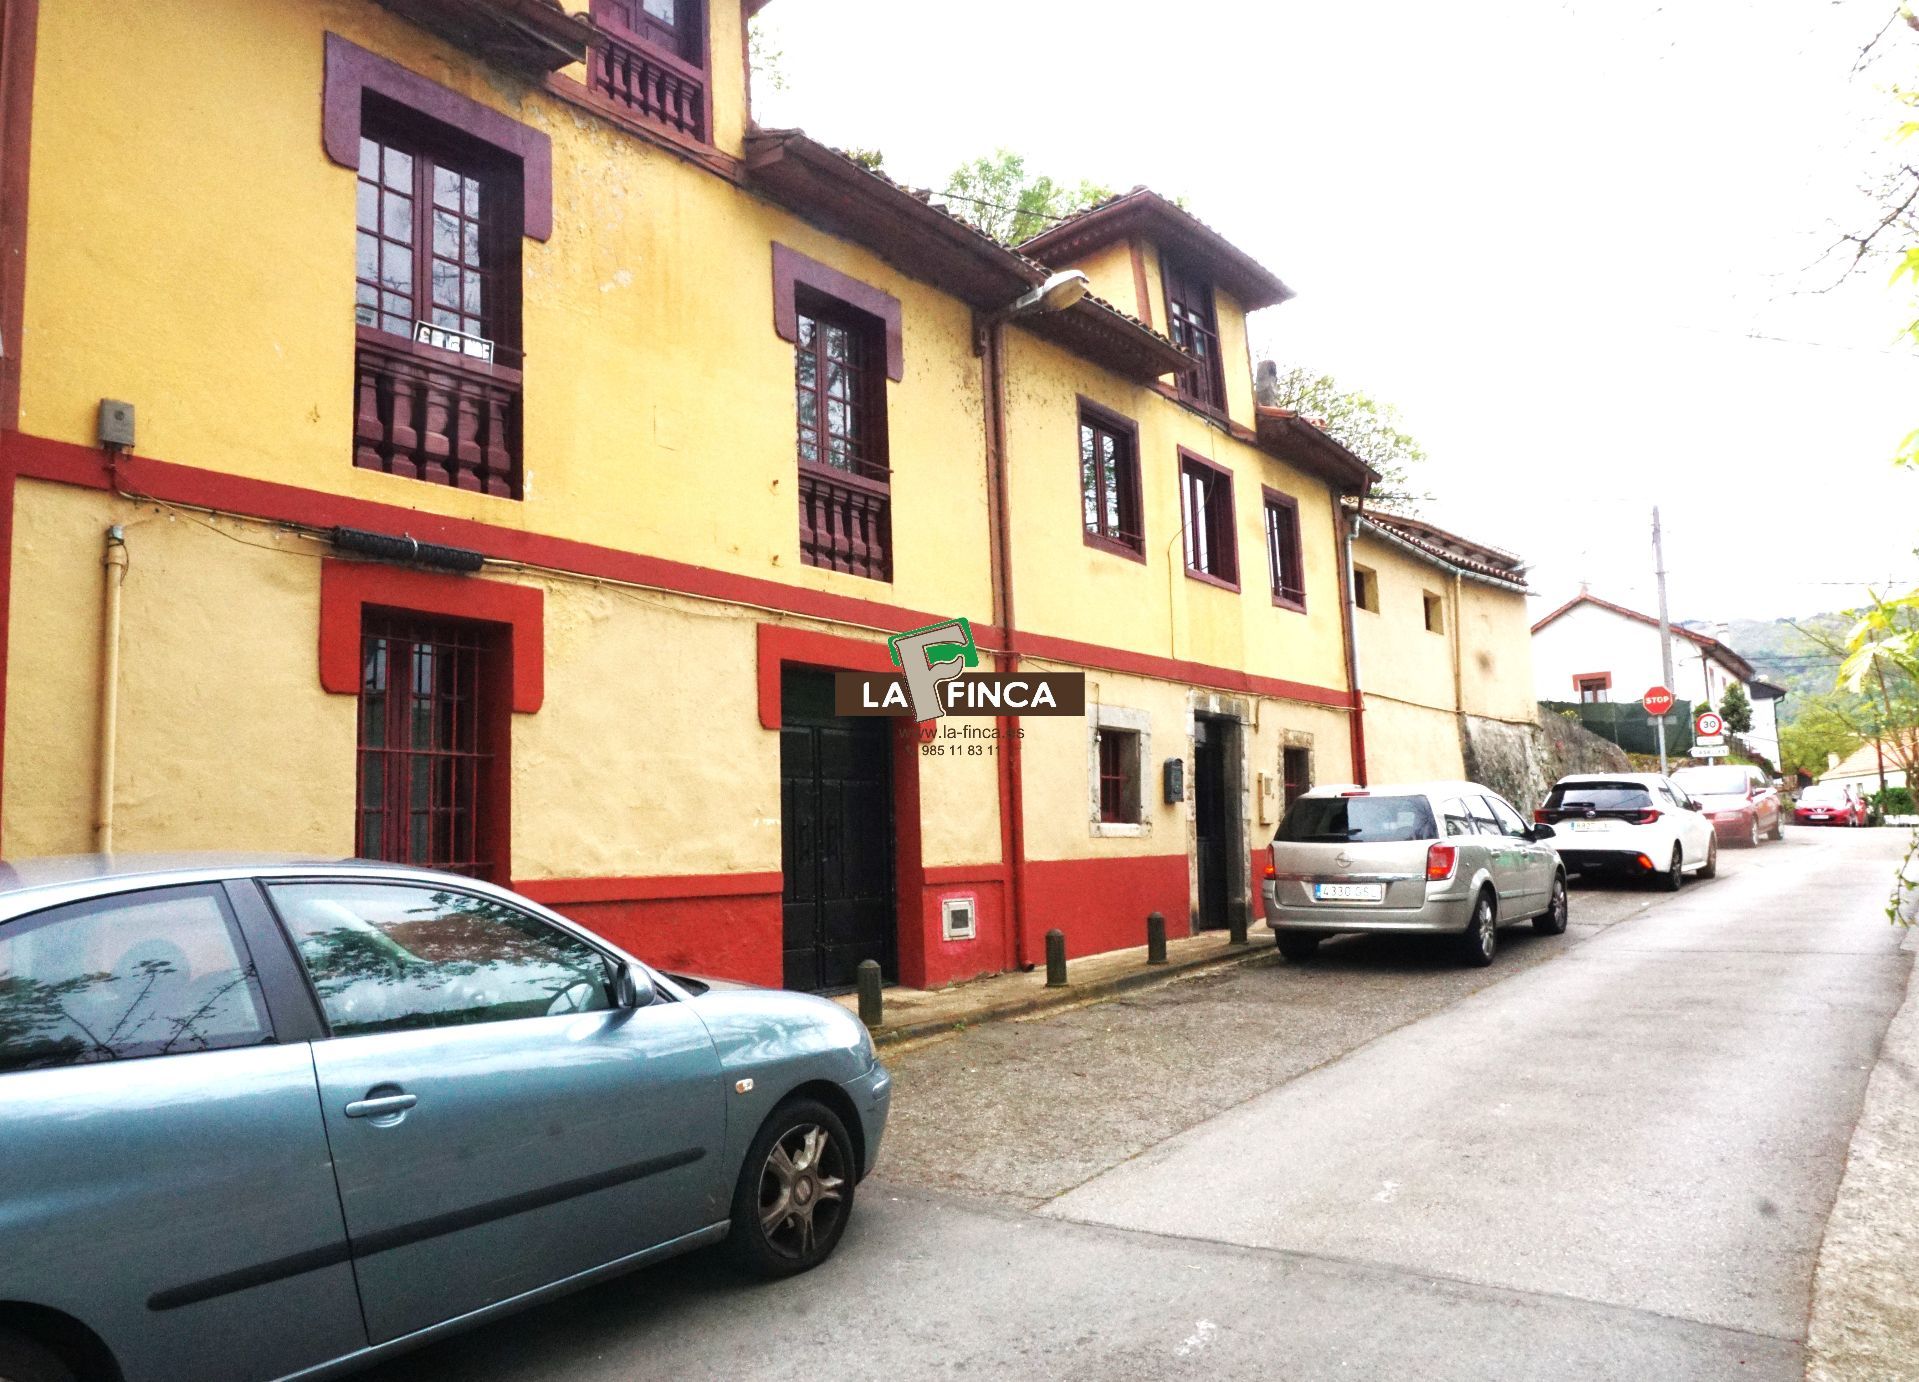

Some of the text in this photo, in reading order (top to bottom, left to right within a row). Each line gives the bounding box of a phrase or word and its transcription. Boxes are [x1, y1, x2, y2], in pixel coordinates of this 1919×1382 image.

[1645, 695, 1670, 704] STOP
[1703, 720, 1717, 729] 30
[1323, 886, 1351, 897] 4330
